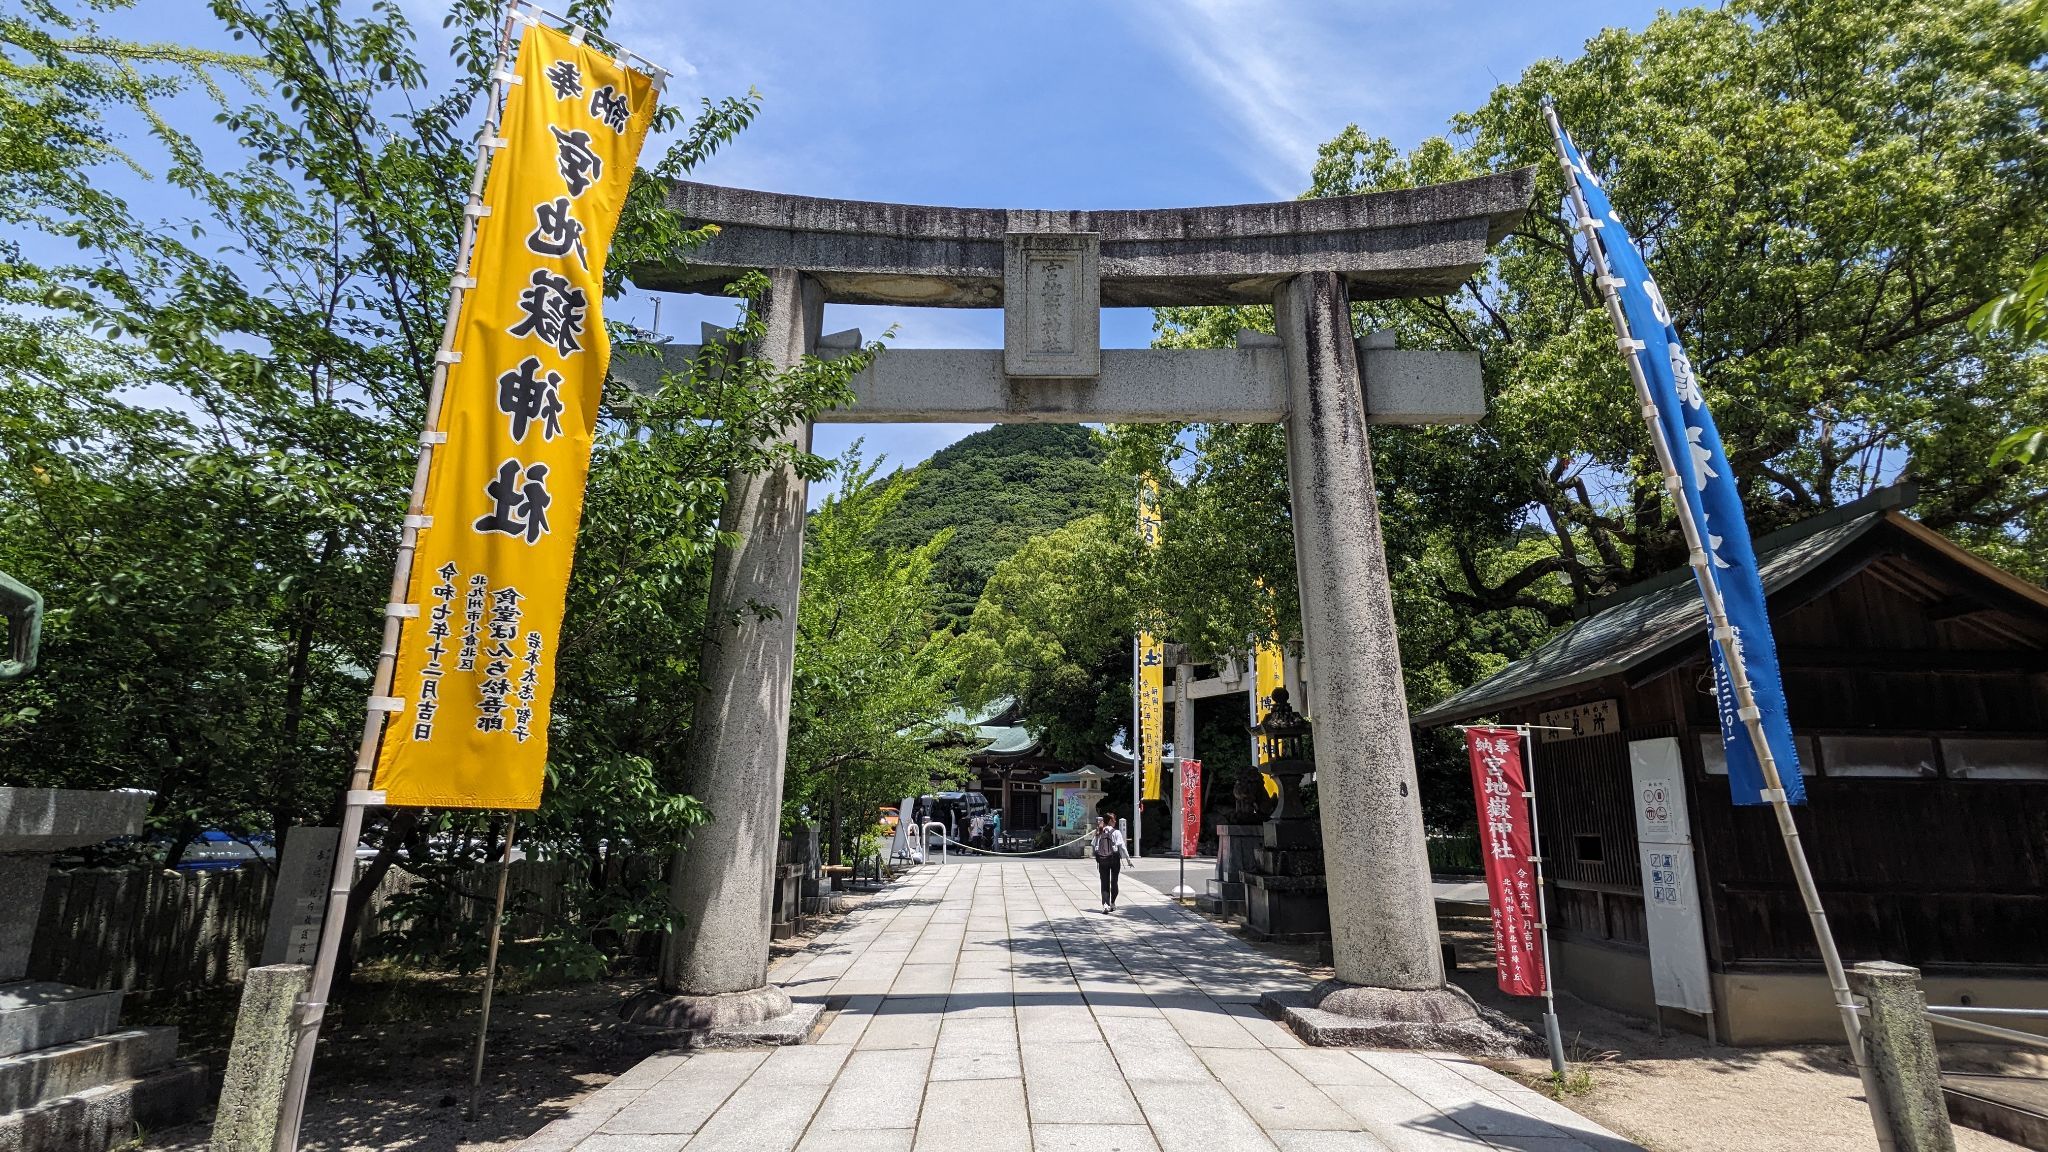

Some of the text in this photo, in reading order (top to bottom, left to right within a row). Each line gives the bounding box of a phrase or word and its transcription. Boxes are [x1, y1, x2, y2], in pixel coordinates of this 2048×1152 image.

[1475, 737, 1510, 754] 奉納
[1482, 755, 1515, 860] 宮地嶽神社
[1515, 868, 1534, 951] 令和六年一月吉日
